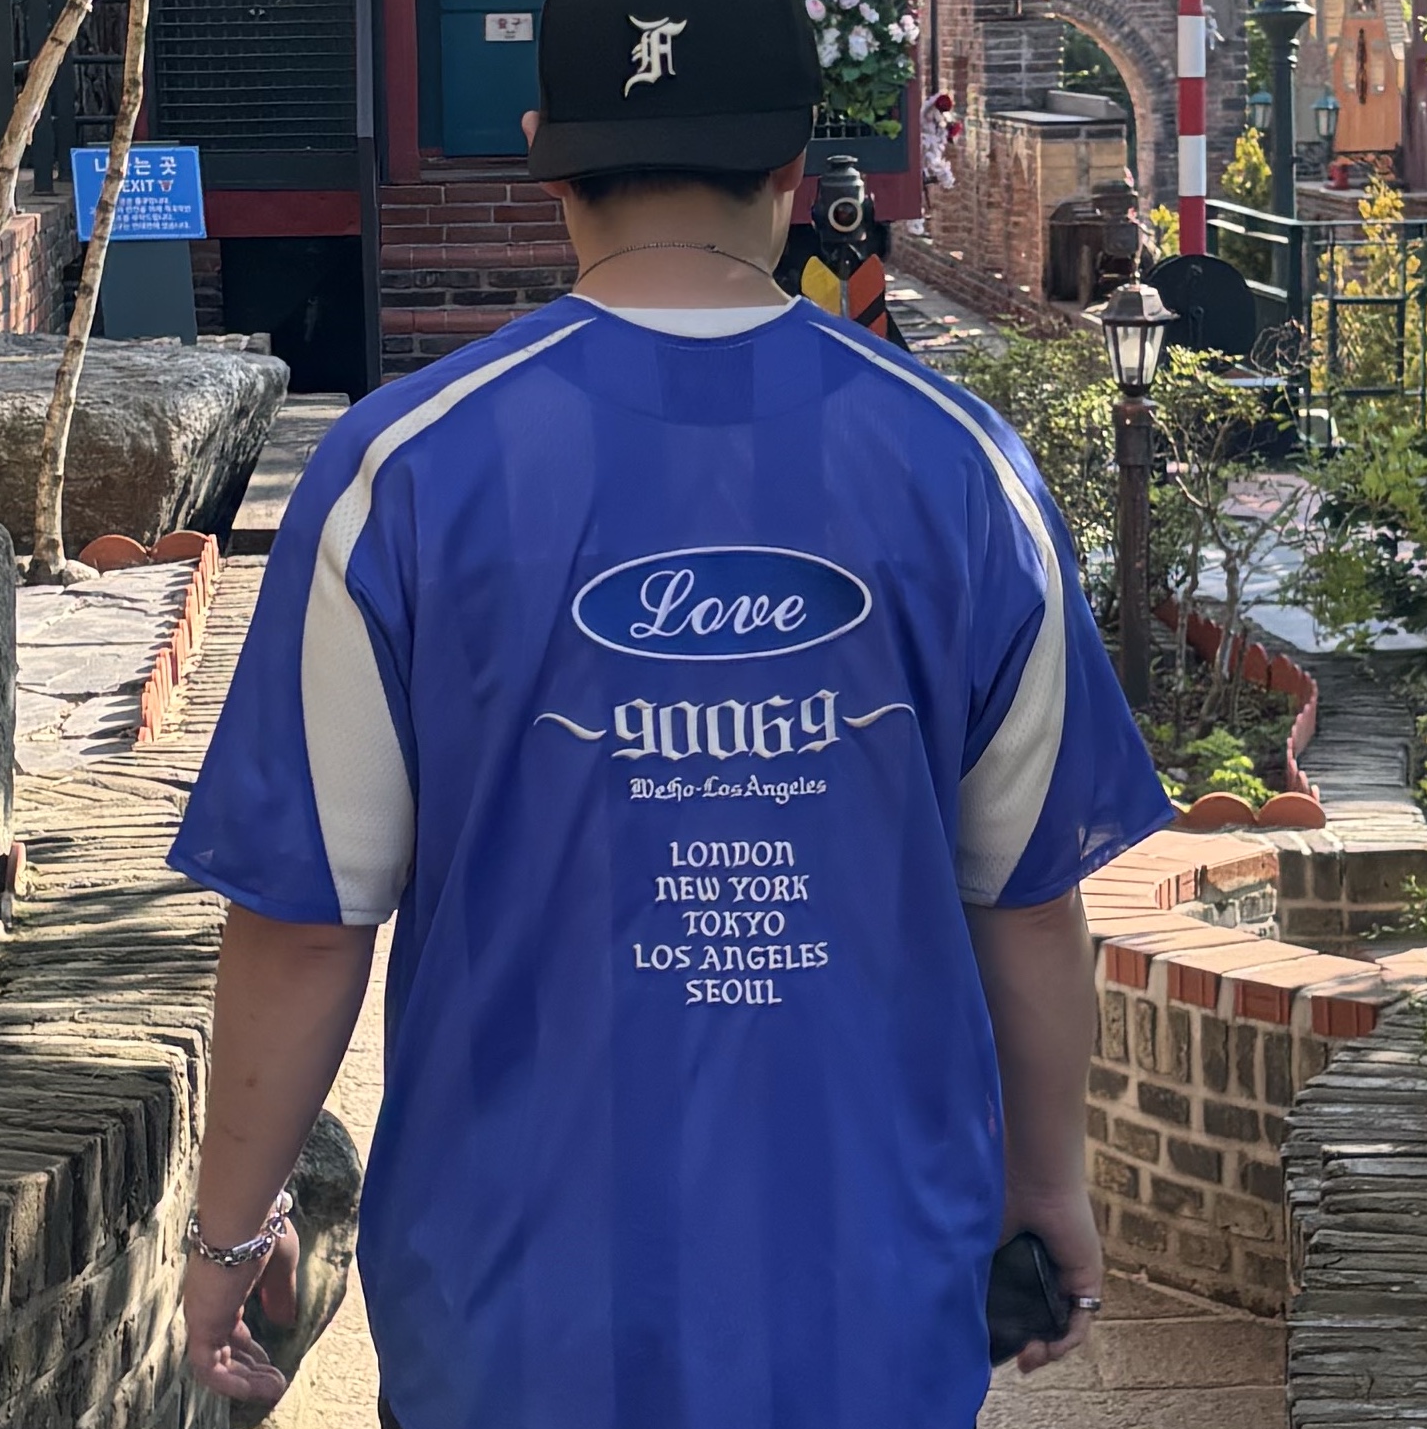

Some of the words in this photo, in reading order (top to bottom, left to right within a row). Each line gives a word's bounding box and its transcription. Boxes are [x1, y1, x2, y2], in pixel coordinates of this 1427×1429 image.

[94, 156, 152, 176] 나는
[159, 156, 178, 176] 곳
[121, 179, 155, 193] EXIT
[629, 568, 807, 639] Love
[612, 689, 840, 761] 90069
[670, 841, 795, 868] LONDON
[655, 876, 720, 902] NEW
[727, 874, 810, 903] YORK
[682, 910, 785, 938] TOKYO
[633, 943, 692, 971] LOS
[698, 941, 829, 972] ANGELES
[685, 978, 782, 1005] SEOUL
